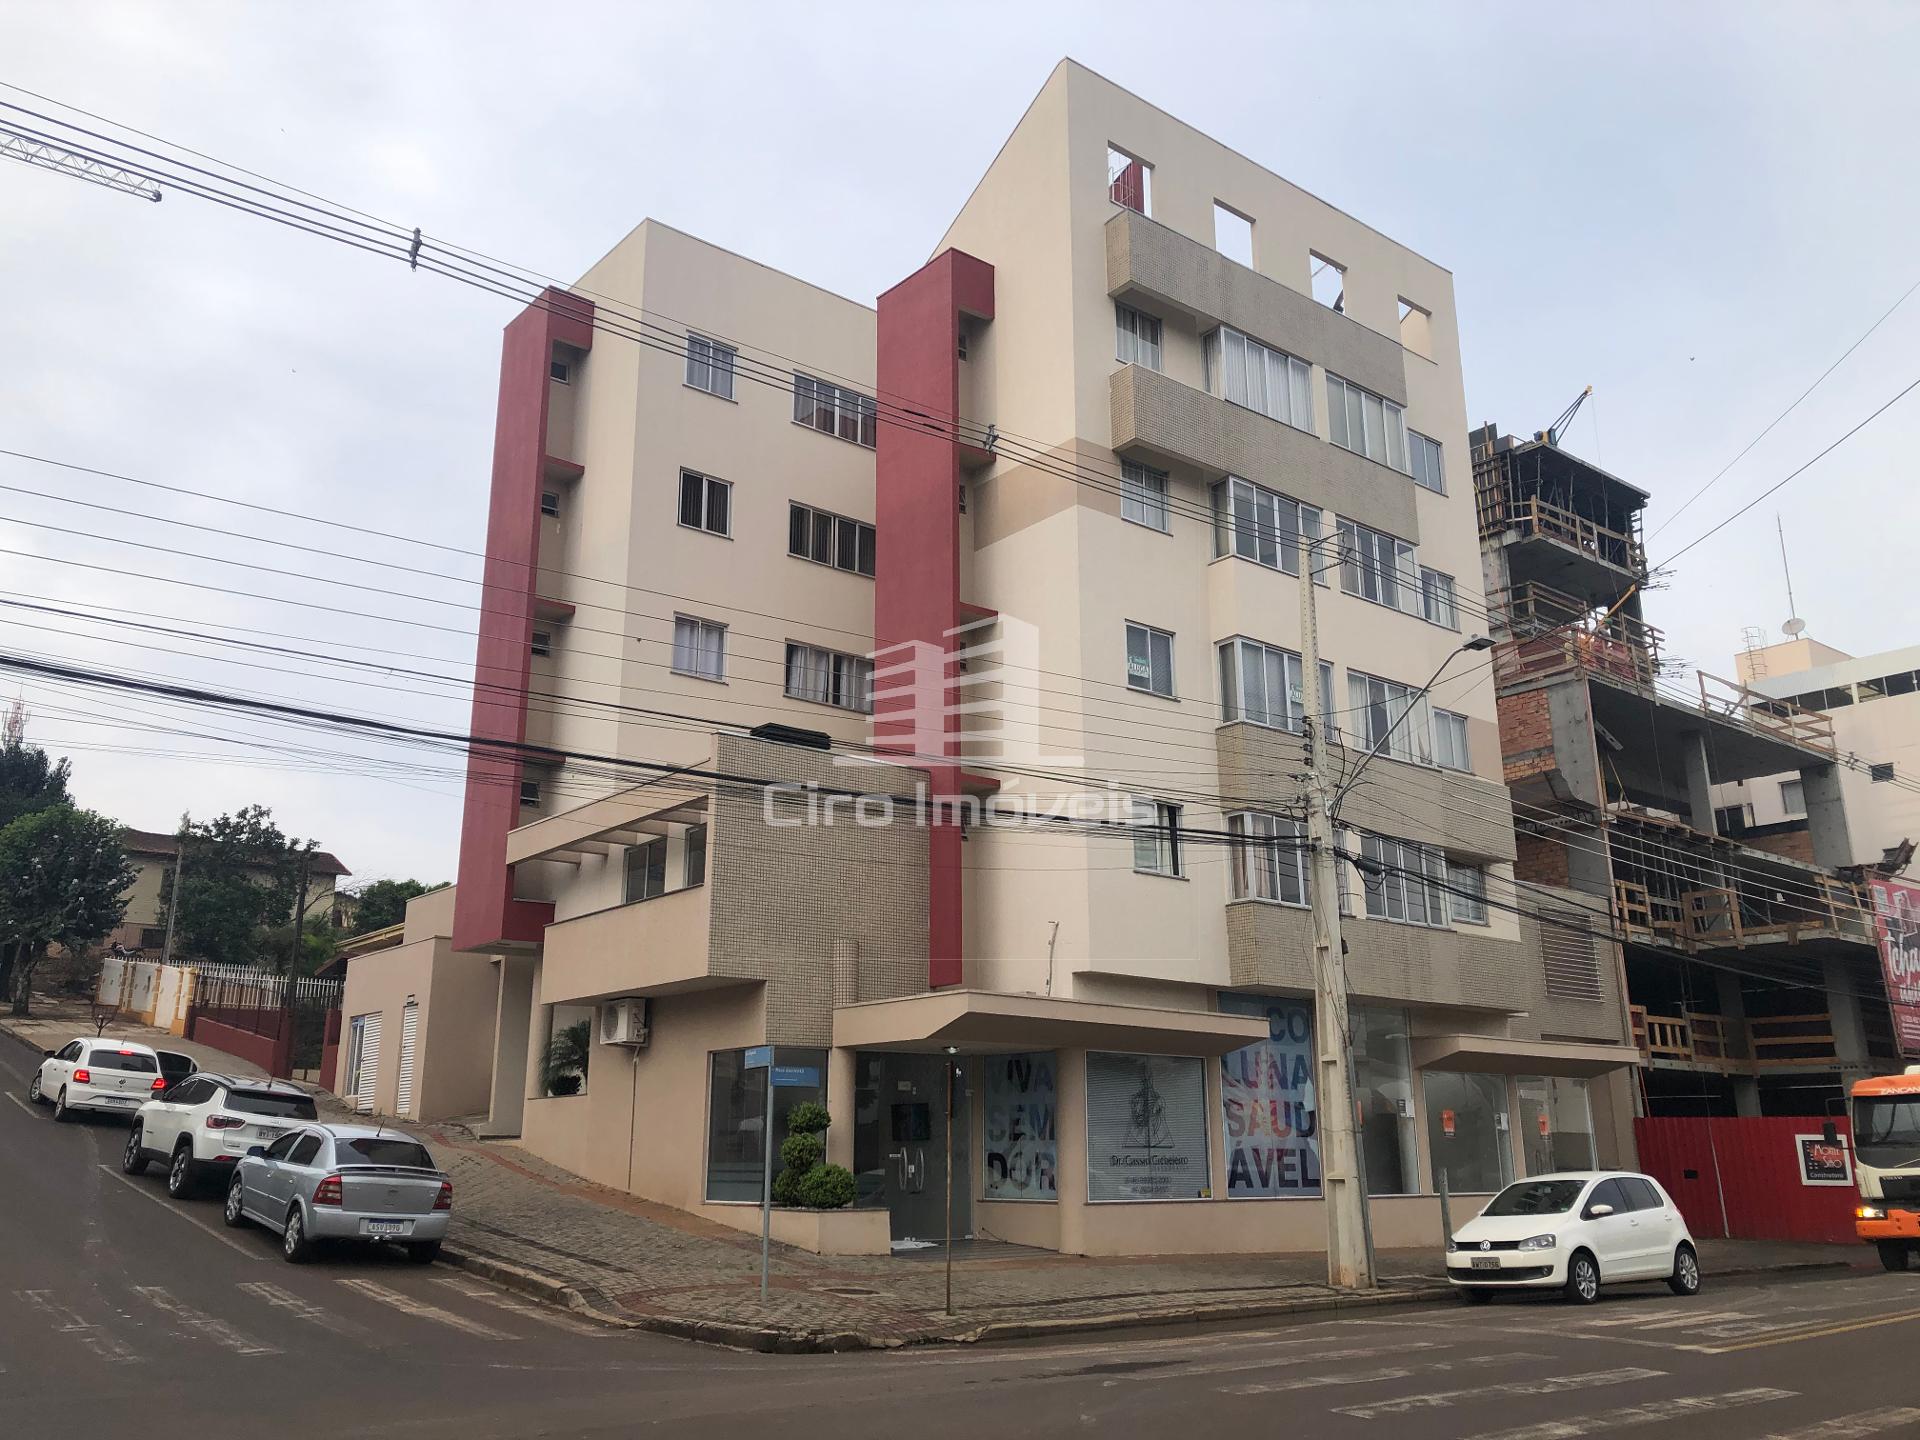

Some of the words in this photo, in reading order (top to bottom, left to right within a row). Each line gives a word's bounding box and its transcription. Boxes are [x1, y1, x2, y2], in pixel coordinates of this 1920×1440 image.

[1266, 1006, 1311, 1043] CO
[1222, 1050, 1311, 1091] LUNA
[988, 1103, 1056, 1142] SEM
[1226, 1097, 1316, 1138] SAUD
[987, 1152, 1056, 1190] DOR
[1228, 1140, 1321, 1189] ÁVEL
